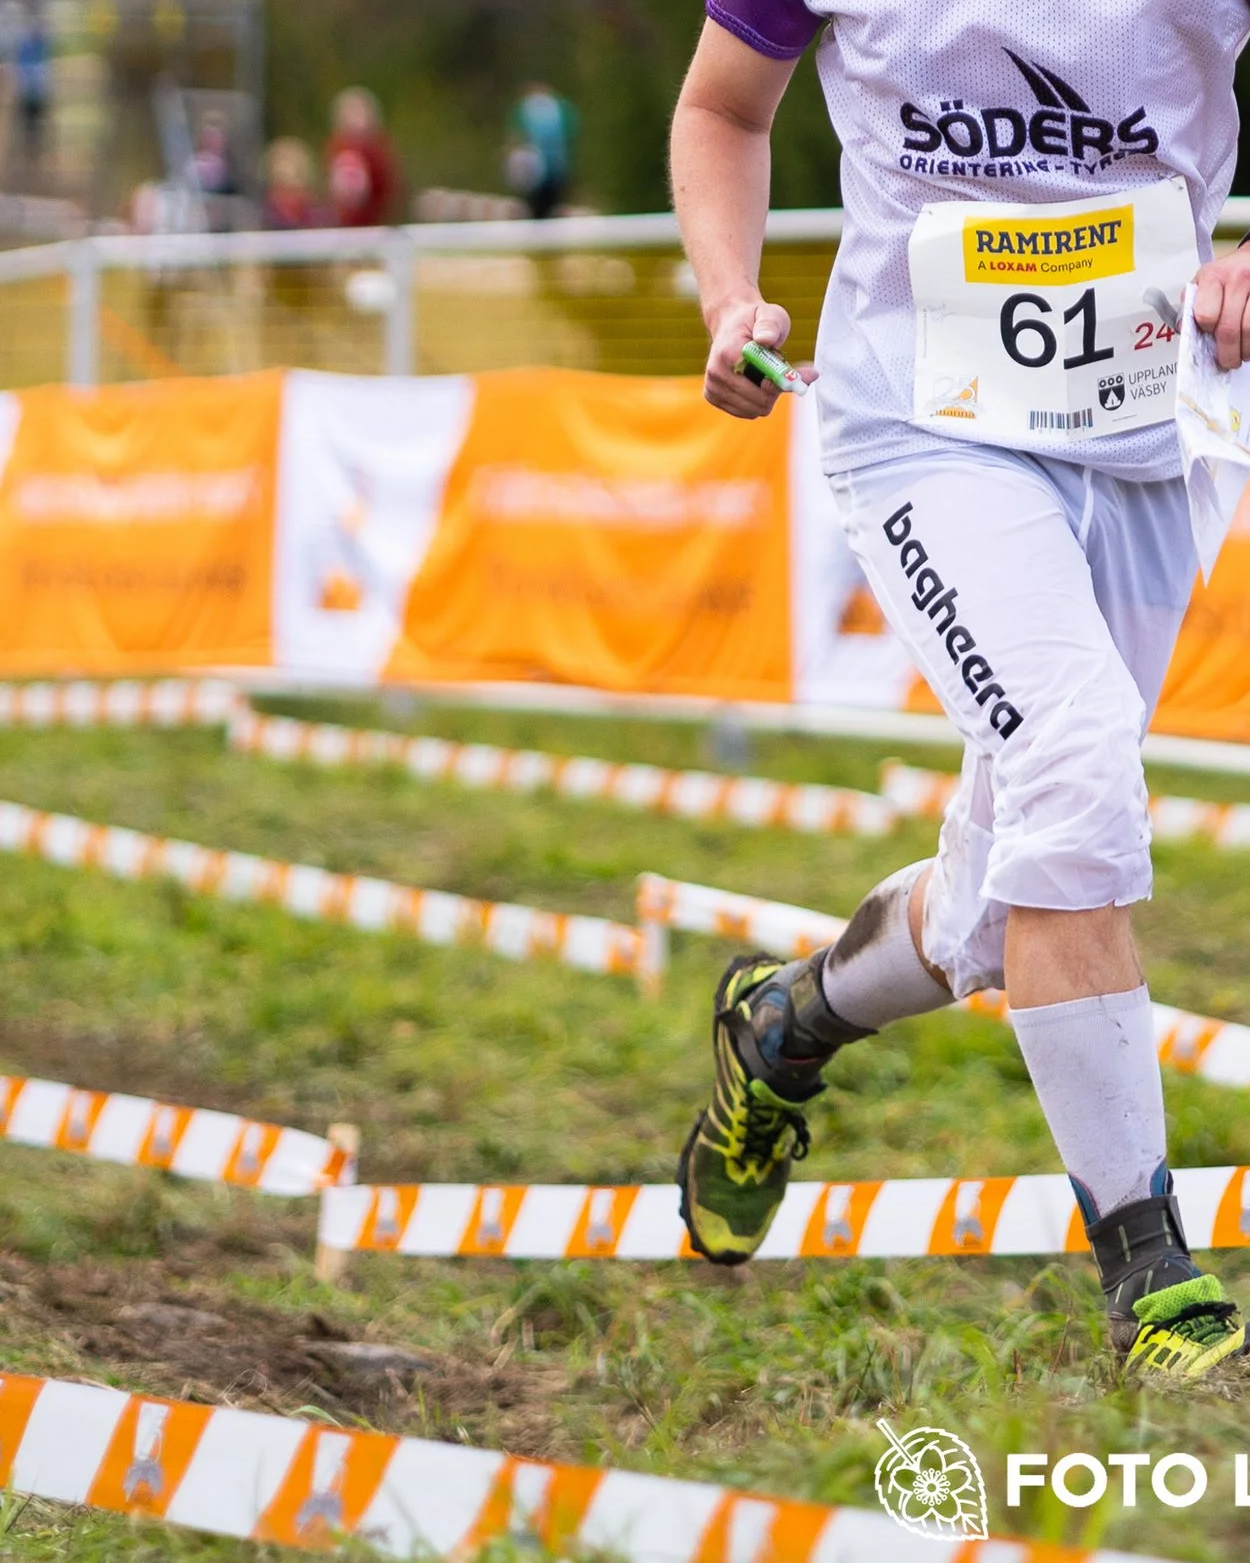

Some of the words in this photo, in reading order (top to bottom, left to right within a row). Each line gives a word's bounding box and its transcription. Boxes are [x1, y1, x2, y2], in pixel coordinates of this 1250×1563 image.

[900, 99, 1159, 159] SÖDERS
[900, 154, 1050, 178] ORIENTERING
[976, 220, 1122, 255] RAMIRENT
[978, 261, 987, 271] A
[990, 261, 1037, 272] LOXAM
[1040, 258, 1093, 273] Company
[1000, 287, 1115, 370] 61
[1130, 381, 1168, 400] VÄSBY
[883, 501, 1025, 741] bagheera
